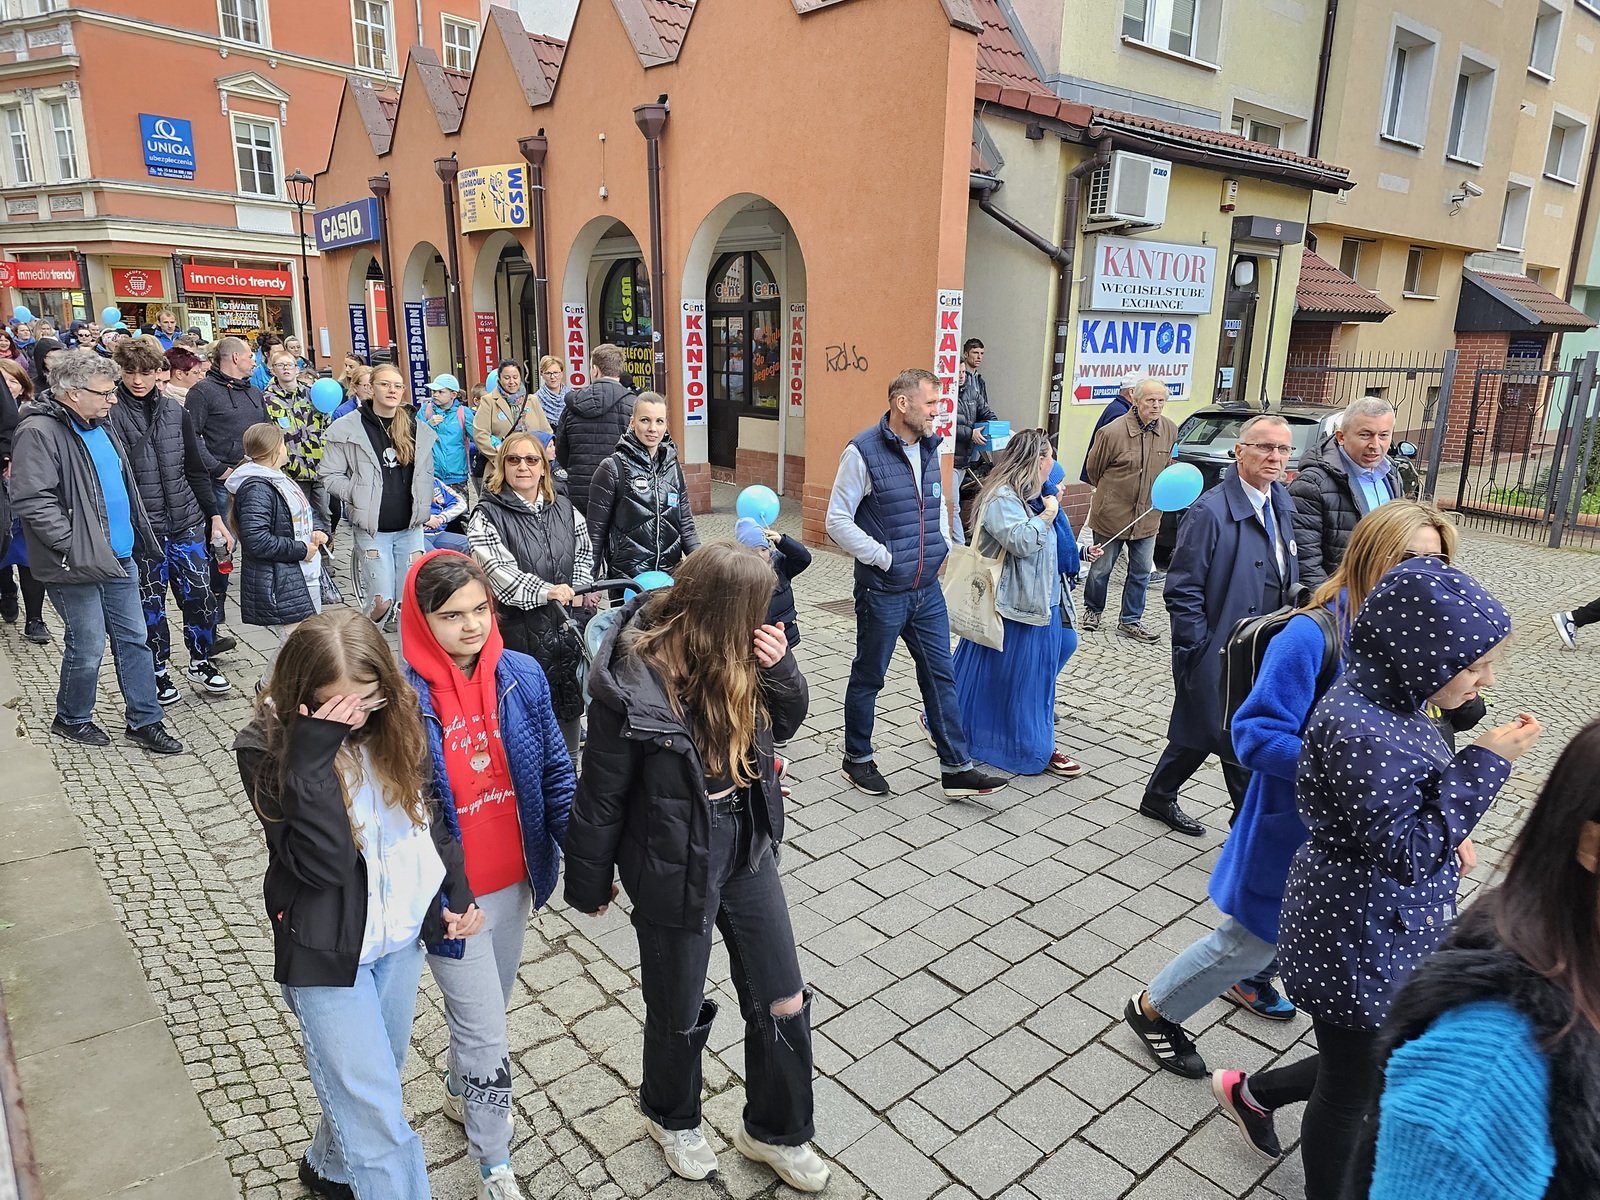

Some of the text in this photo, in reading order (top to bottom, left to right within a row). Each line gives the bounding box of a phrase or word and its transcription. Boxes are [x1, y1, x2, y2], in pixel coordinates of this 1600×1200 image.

[147, 140, 191, 156] UNIQA
[149, 155, 193, 166] ubezpieczenia
[507, 167, 525, 224] GSM
[321, 209, 361, 243] CASIO
[1101, 245, 1207, 284] KANTOR
[51, 268, 76, 282] trendy
[190, 271, 287, 291] inmedio trendy
[1101, 282, 1205, 298] WECHSELSTUBE
[222, 302, 259, 311] OTWARTE
[683, 303, 705, 312] Cent
[790, 304, 805, 313] Cent
[940, 295, 962, 306] Cent
[1121, 298, 1184, 310] EXCHANGE
[564, 305, 585, 314] Cent
[352, 310, 368, 357] ZEGARM
[1081, 319, 1192, 355] KANTOR
[484, 336, 494, 374] TELE
[567, 316, 586, 392] KANTO
[623, 347, 654, 361] ELEFONY
[791, 316, 804, 406] KANTOR
[1080, 364, 1189, 378] WYMIANY WALUT
[464, 1086, 509, 1106] URBA
[469, 1103, 506, 1119] APPAR
